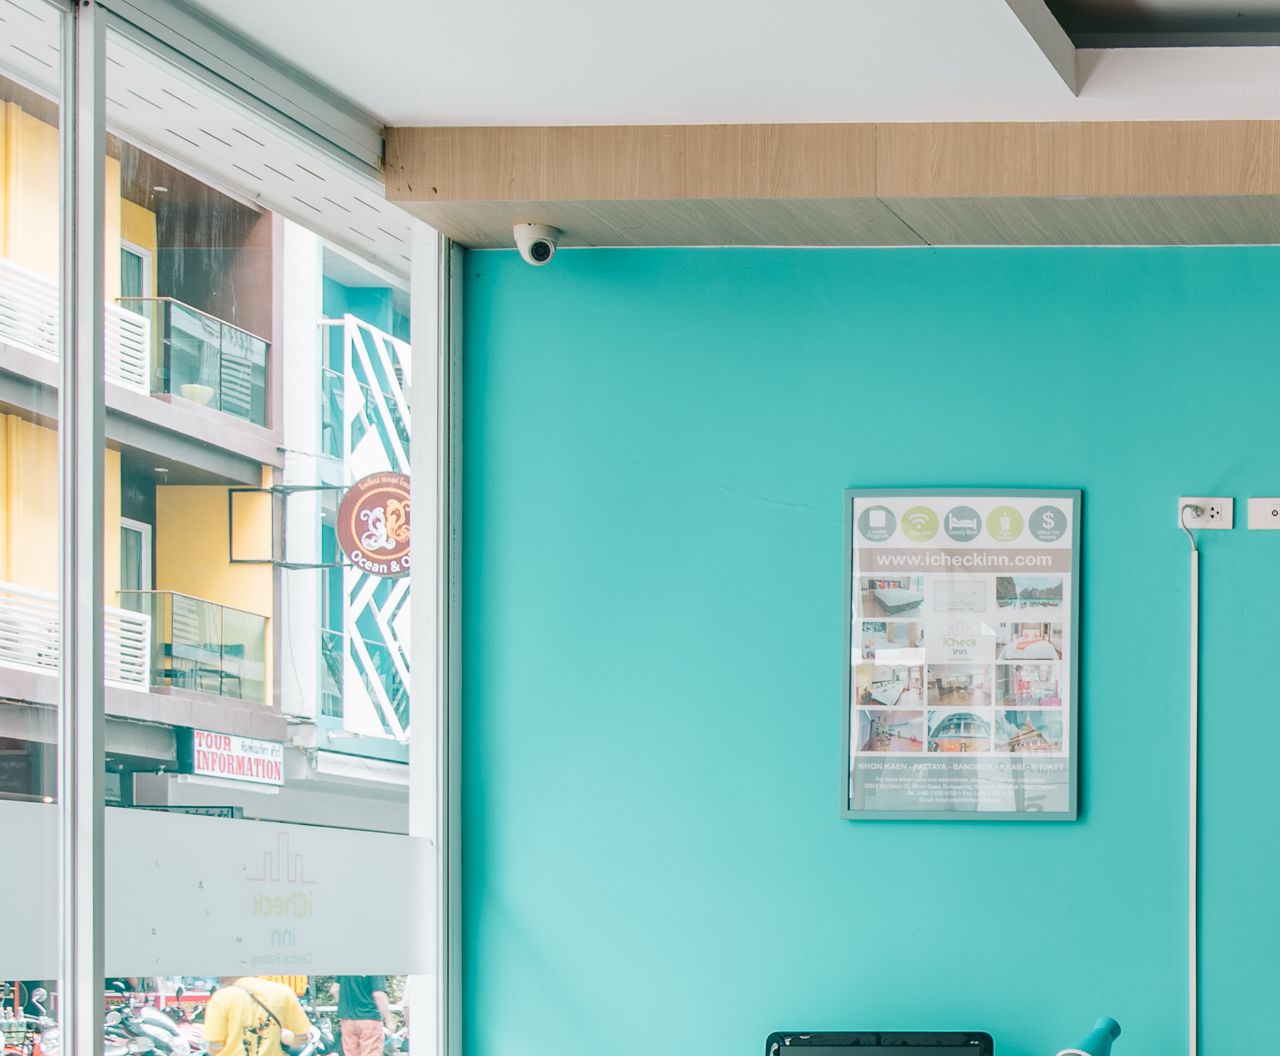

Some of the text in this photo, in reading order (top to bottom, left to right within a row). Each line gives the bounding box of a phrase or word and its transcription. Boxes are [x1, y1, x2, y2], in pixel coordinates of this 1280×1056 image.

[352, 551, 388, 572] Ocean
[390, 561, 401, 572] &
[877, 552, 1052, 567] www.icheckinn.com
[943, 637, 977, 647] iCheck
[195, 731, 231, 752] TOUR
[196, 750, 281, 780] INFORMATION
